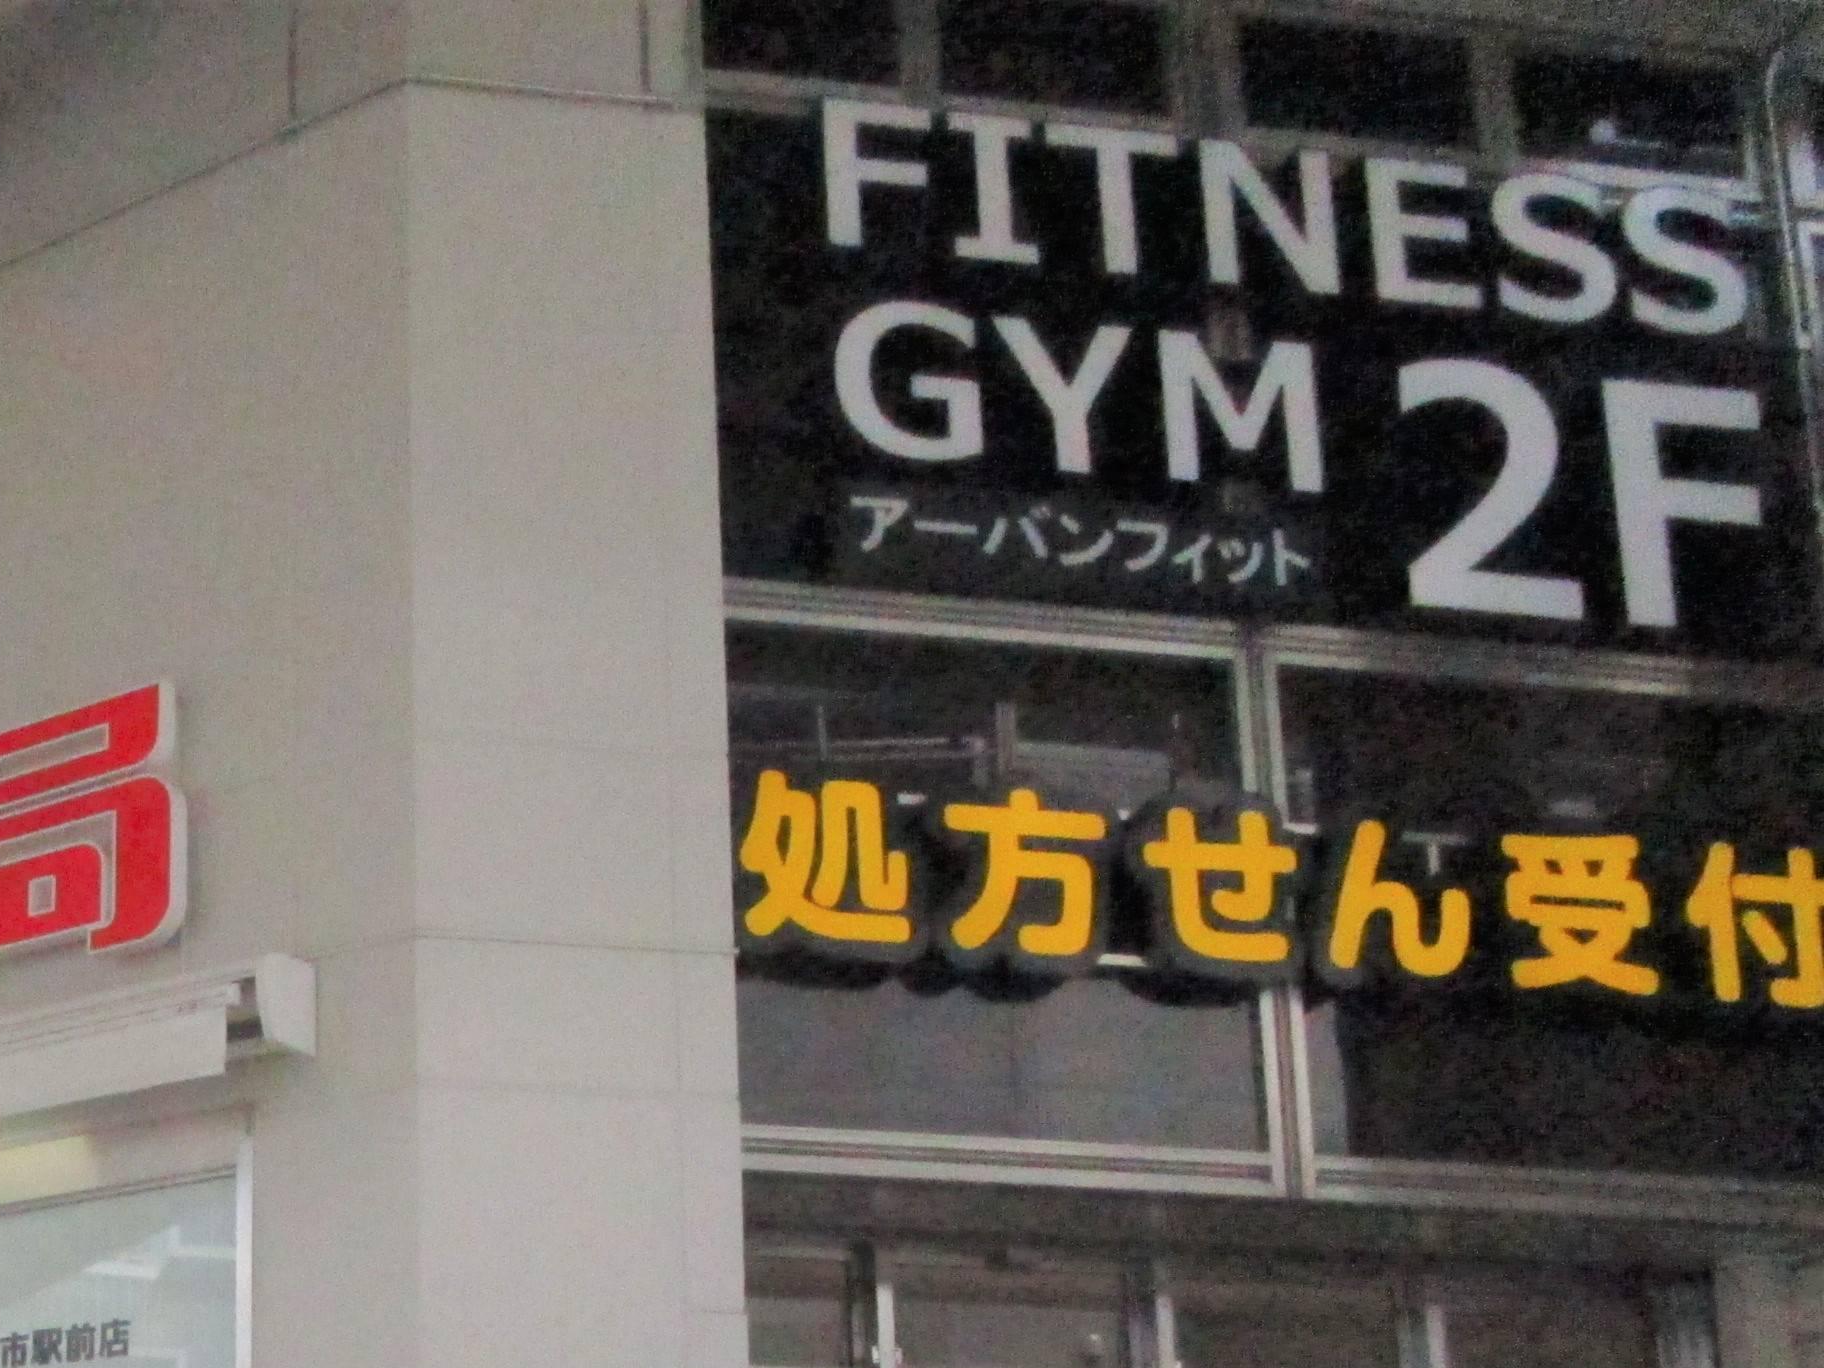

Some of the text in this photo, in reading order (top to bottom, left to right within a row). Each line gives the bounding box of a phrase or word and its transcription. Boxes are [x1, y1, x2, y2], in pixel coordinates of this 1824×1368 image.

[821, 96, 1750, 336] FITNESS
[833, 299, 1763, 629] GYM 2F
[849, 494, 1313, 588] アーバンフィット
[739, 769, 1824, 1009] 処方せん受付
